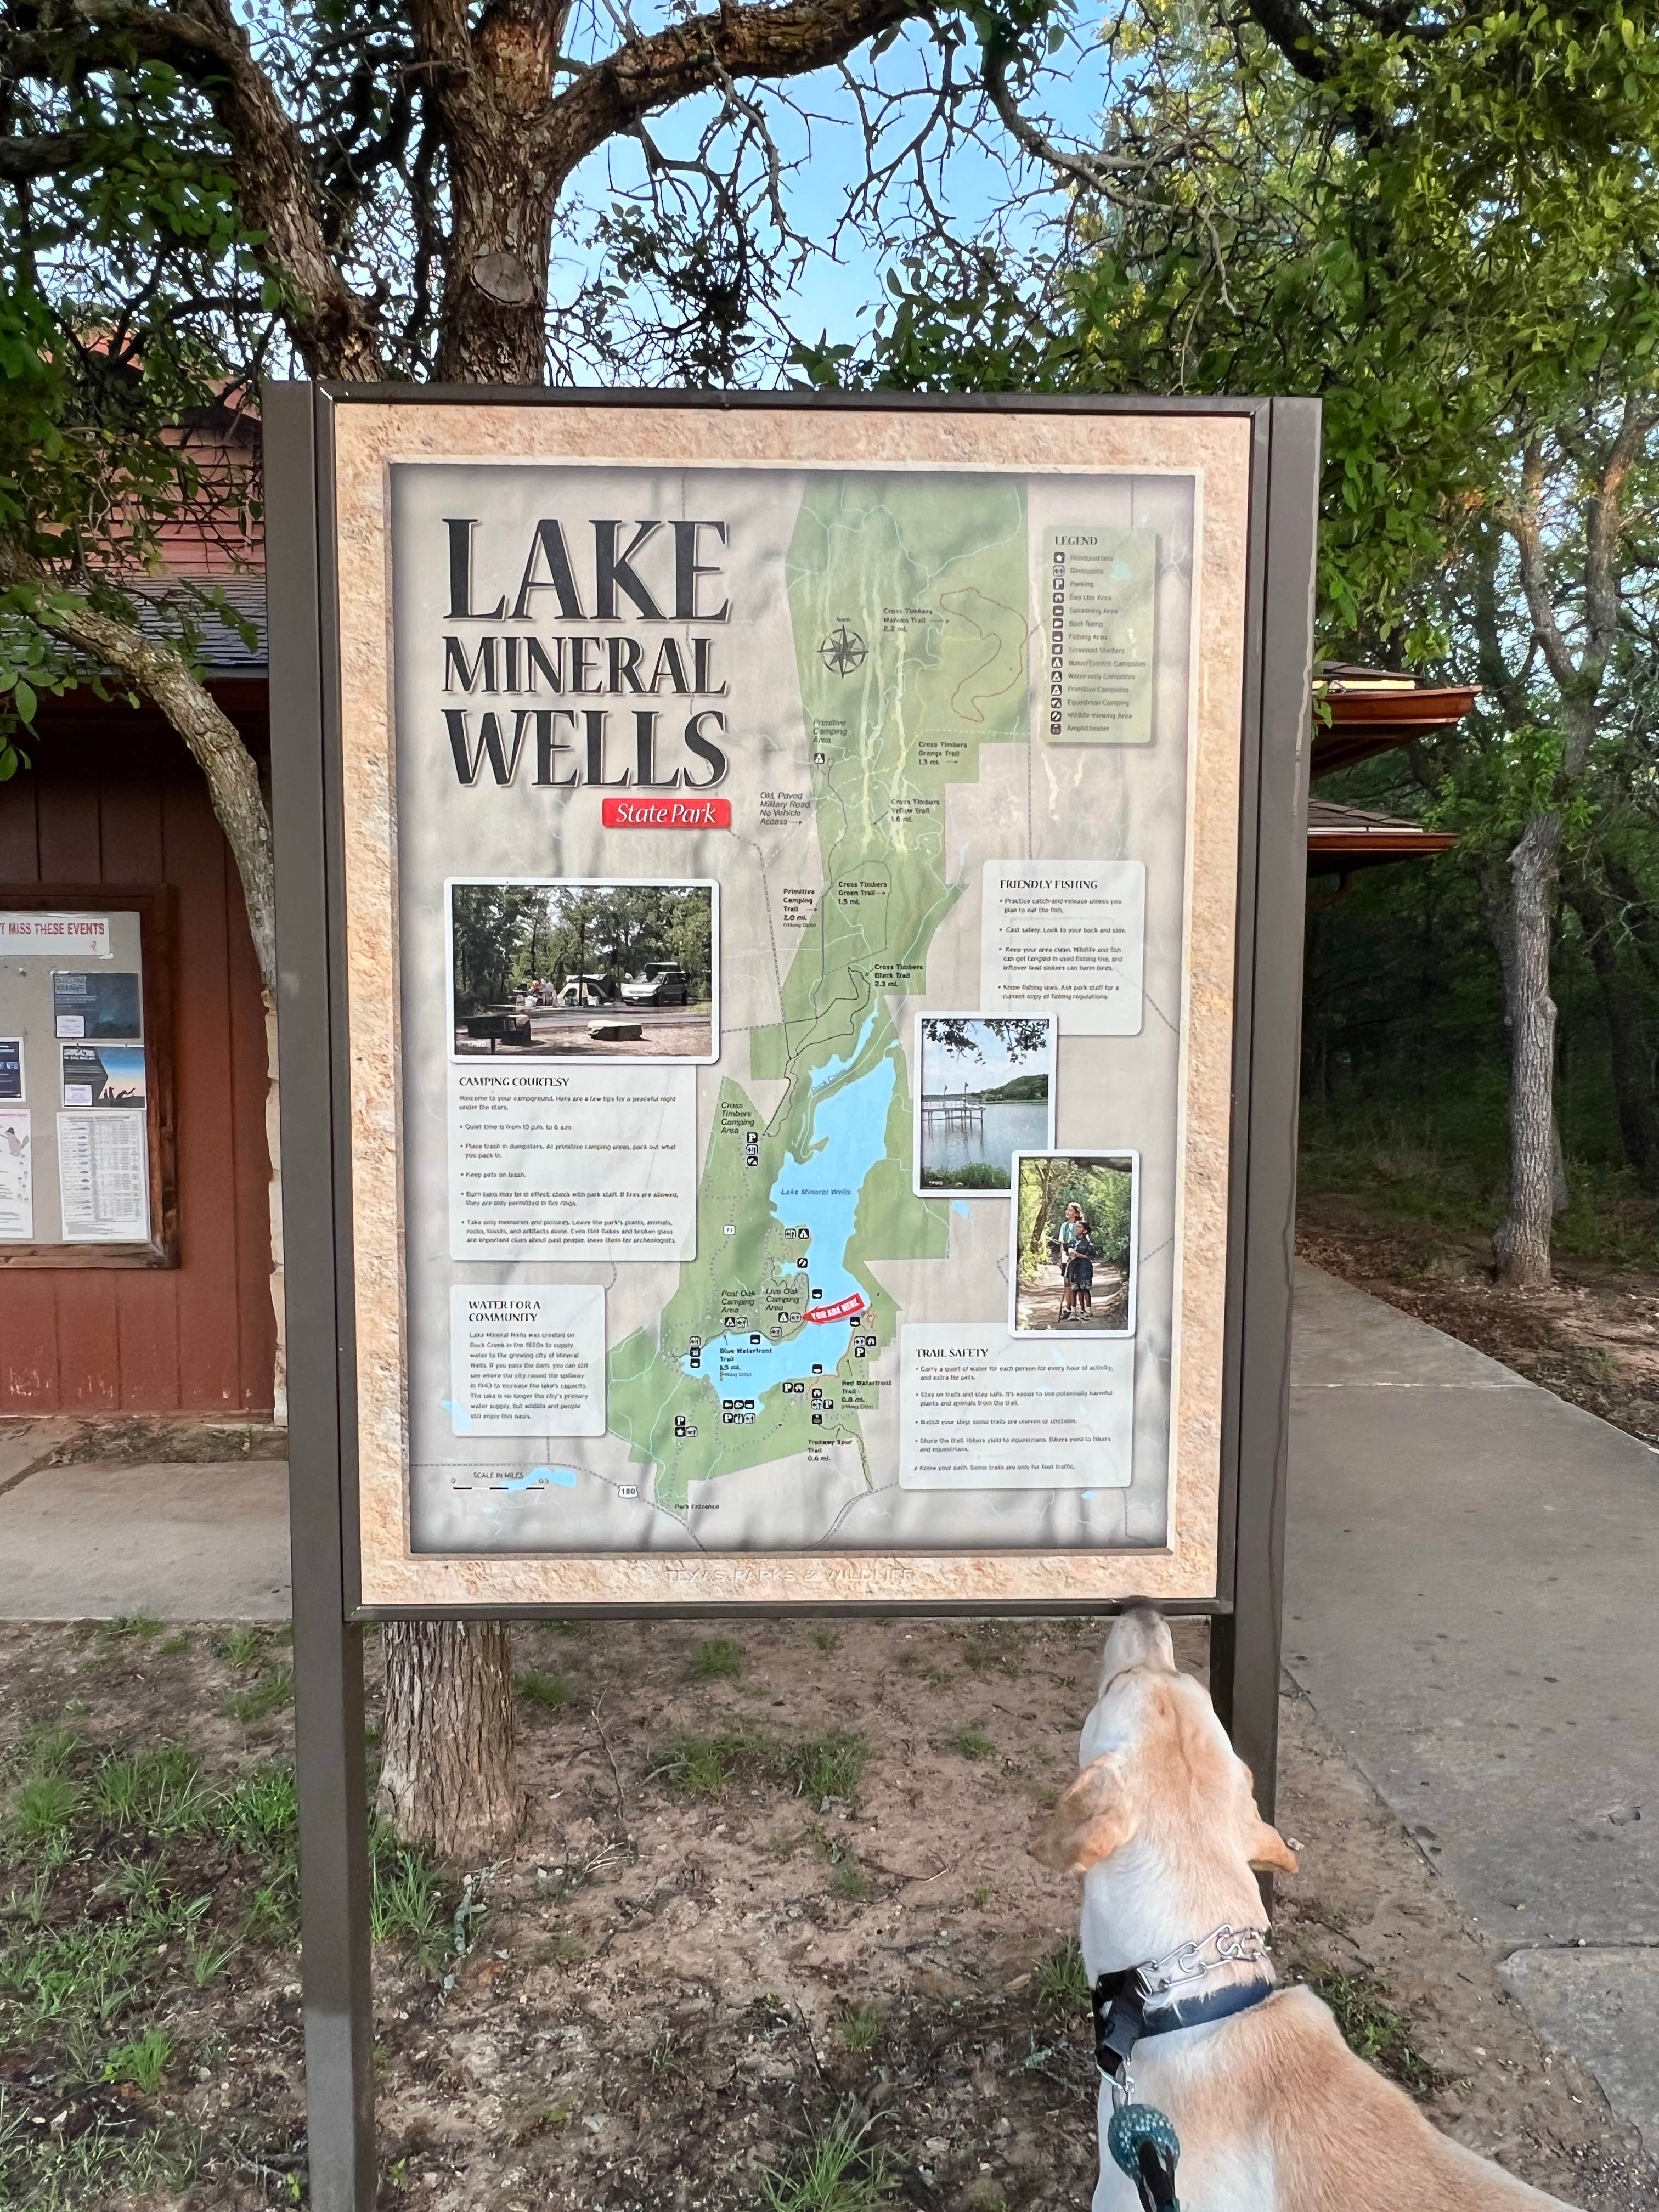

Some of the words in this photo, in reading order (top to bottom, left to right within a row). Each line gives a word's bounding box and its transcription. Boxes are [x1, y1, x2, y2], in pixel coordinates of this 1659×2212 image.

[1055, 536, 1097, 545] LEGEND
[442, 519, 730, 622] LAKE
[442, 636, 727, 694] MINERAL
[441, 709, 728, 787] WELLS
[616, 803, 667, 823] State
[672, 804, 716, 823] Park
[1000, 879, 1052, 888] FRIENDLY
[1054, 880, 1097, 889] FISHING
[8, 923, 31, 934] MISS
[35, 923, 64, 934] THESE
[67, 923, 104, 934] EVENTS
[459, 1077, 509, 1086] CAMPING
[512, 1077, 568, 1086] COURTESY
[469, 1301, 506, 1309] WATER
[510, 1301, 531, 1309] FOR
[533, 1301, 540, 1309] A
[469, 1313, 537, 1321] COMMUNITY
[916, 1348, 946, 1357] TRAIL
[949, 1348, 988, 1357] SAFETY
